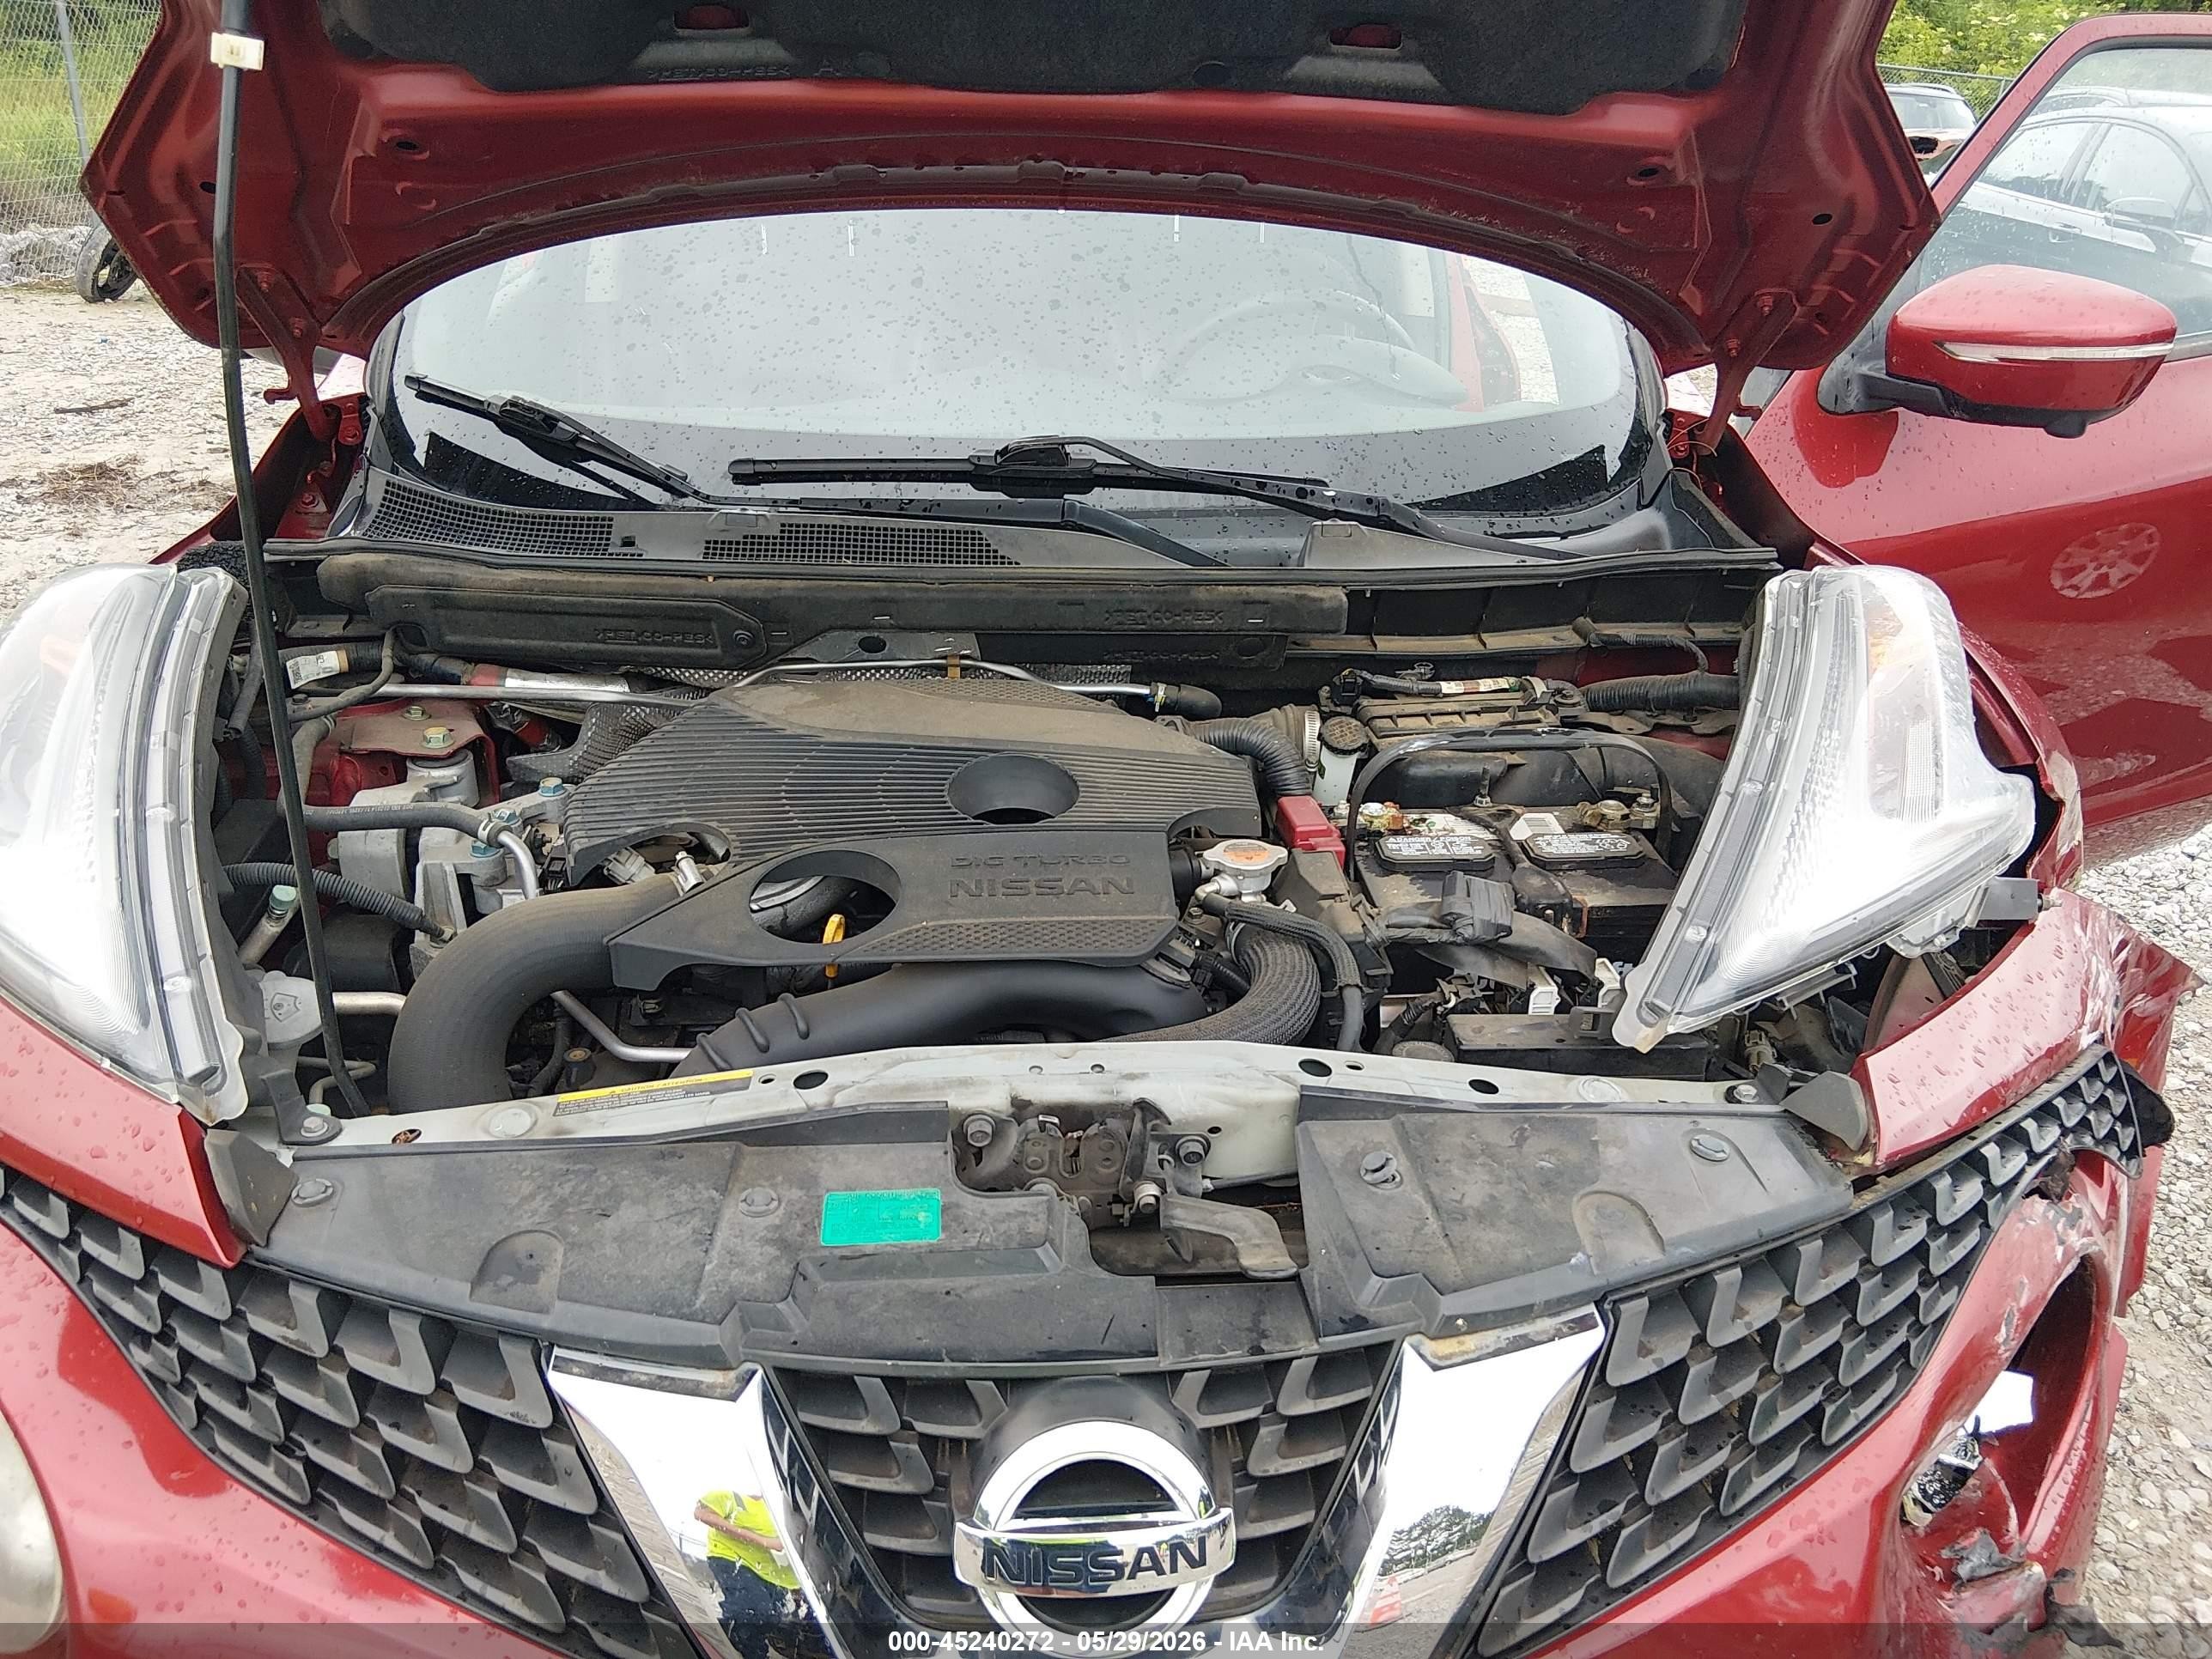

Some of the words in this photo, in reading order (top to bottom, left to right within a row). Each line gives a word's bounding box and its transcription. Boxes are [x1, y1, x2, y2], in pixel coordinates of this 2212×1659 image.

[1012, 854, 1132, 867] TURBO
[949, 877, 1135, 898] NISSAN
[981, 1533, 1207, 1587] NISSAN
